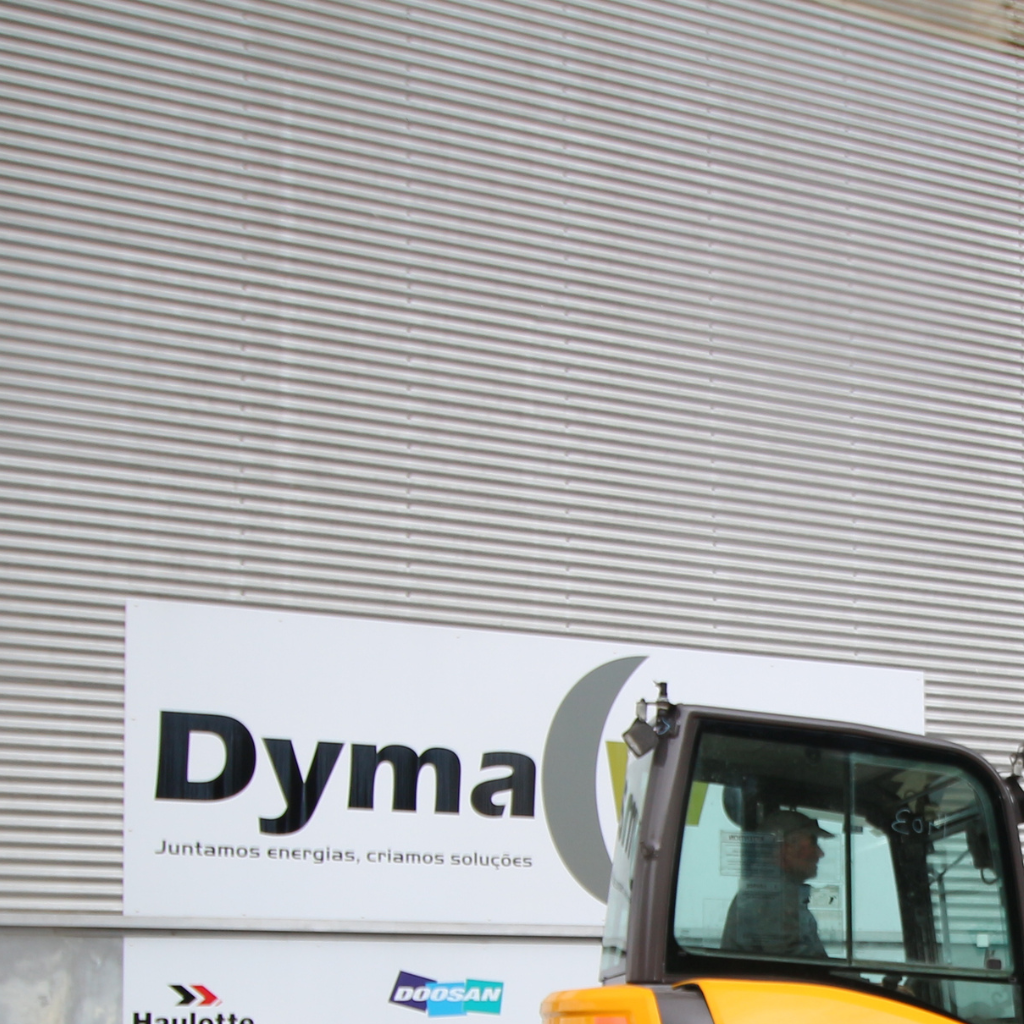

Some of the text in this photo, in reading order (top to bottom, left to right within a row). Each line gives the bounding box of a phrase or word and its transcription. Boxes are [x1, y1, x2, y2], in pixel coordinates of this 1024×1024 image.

[154, 710, 537, 836] Dyma
[155, 840, 533, 870] Juntamos energias, criamos soluções
[393, 986, 502, 1002] DOOSAN
